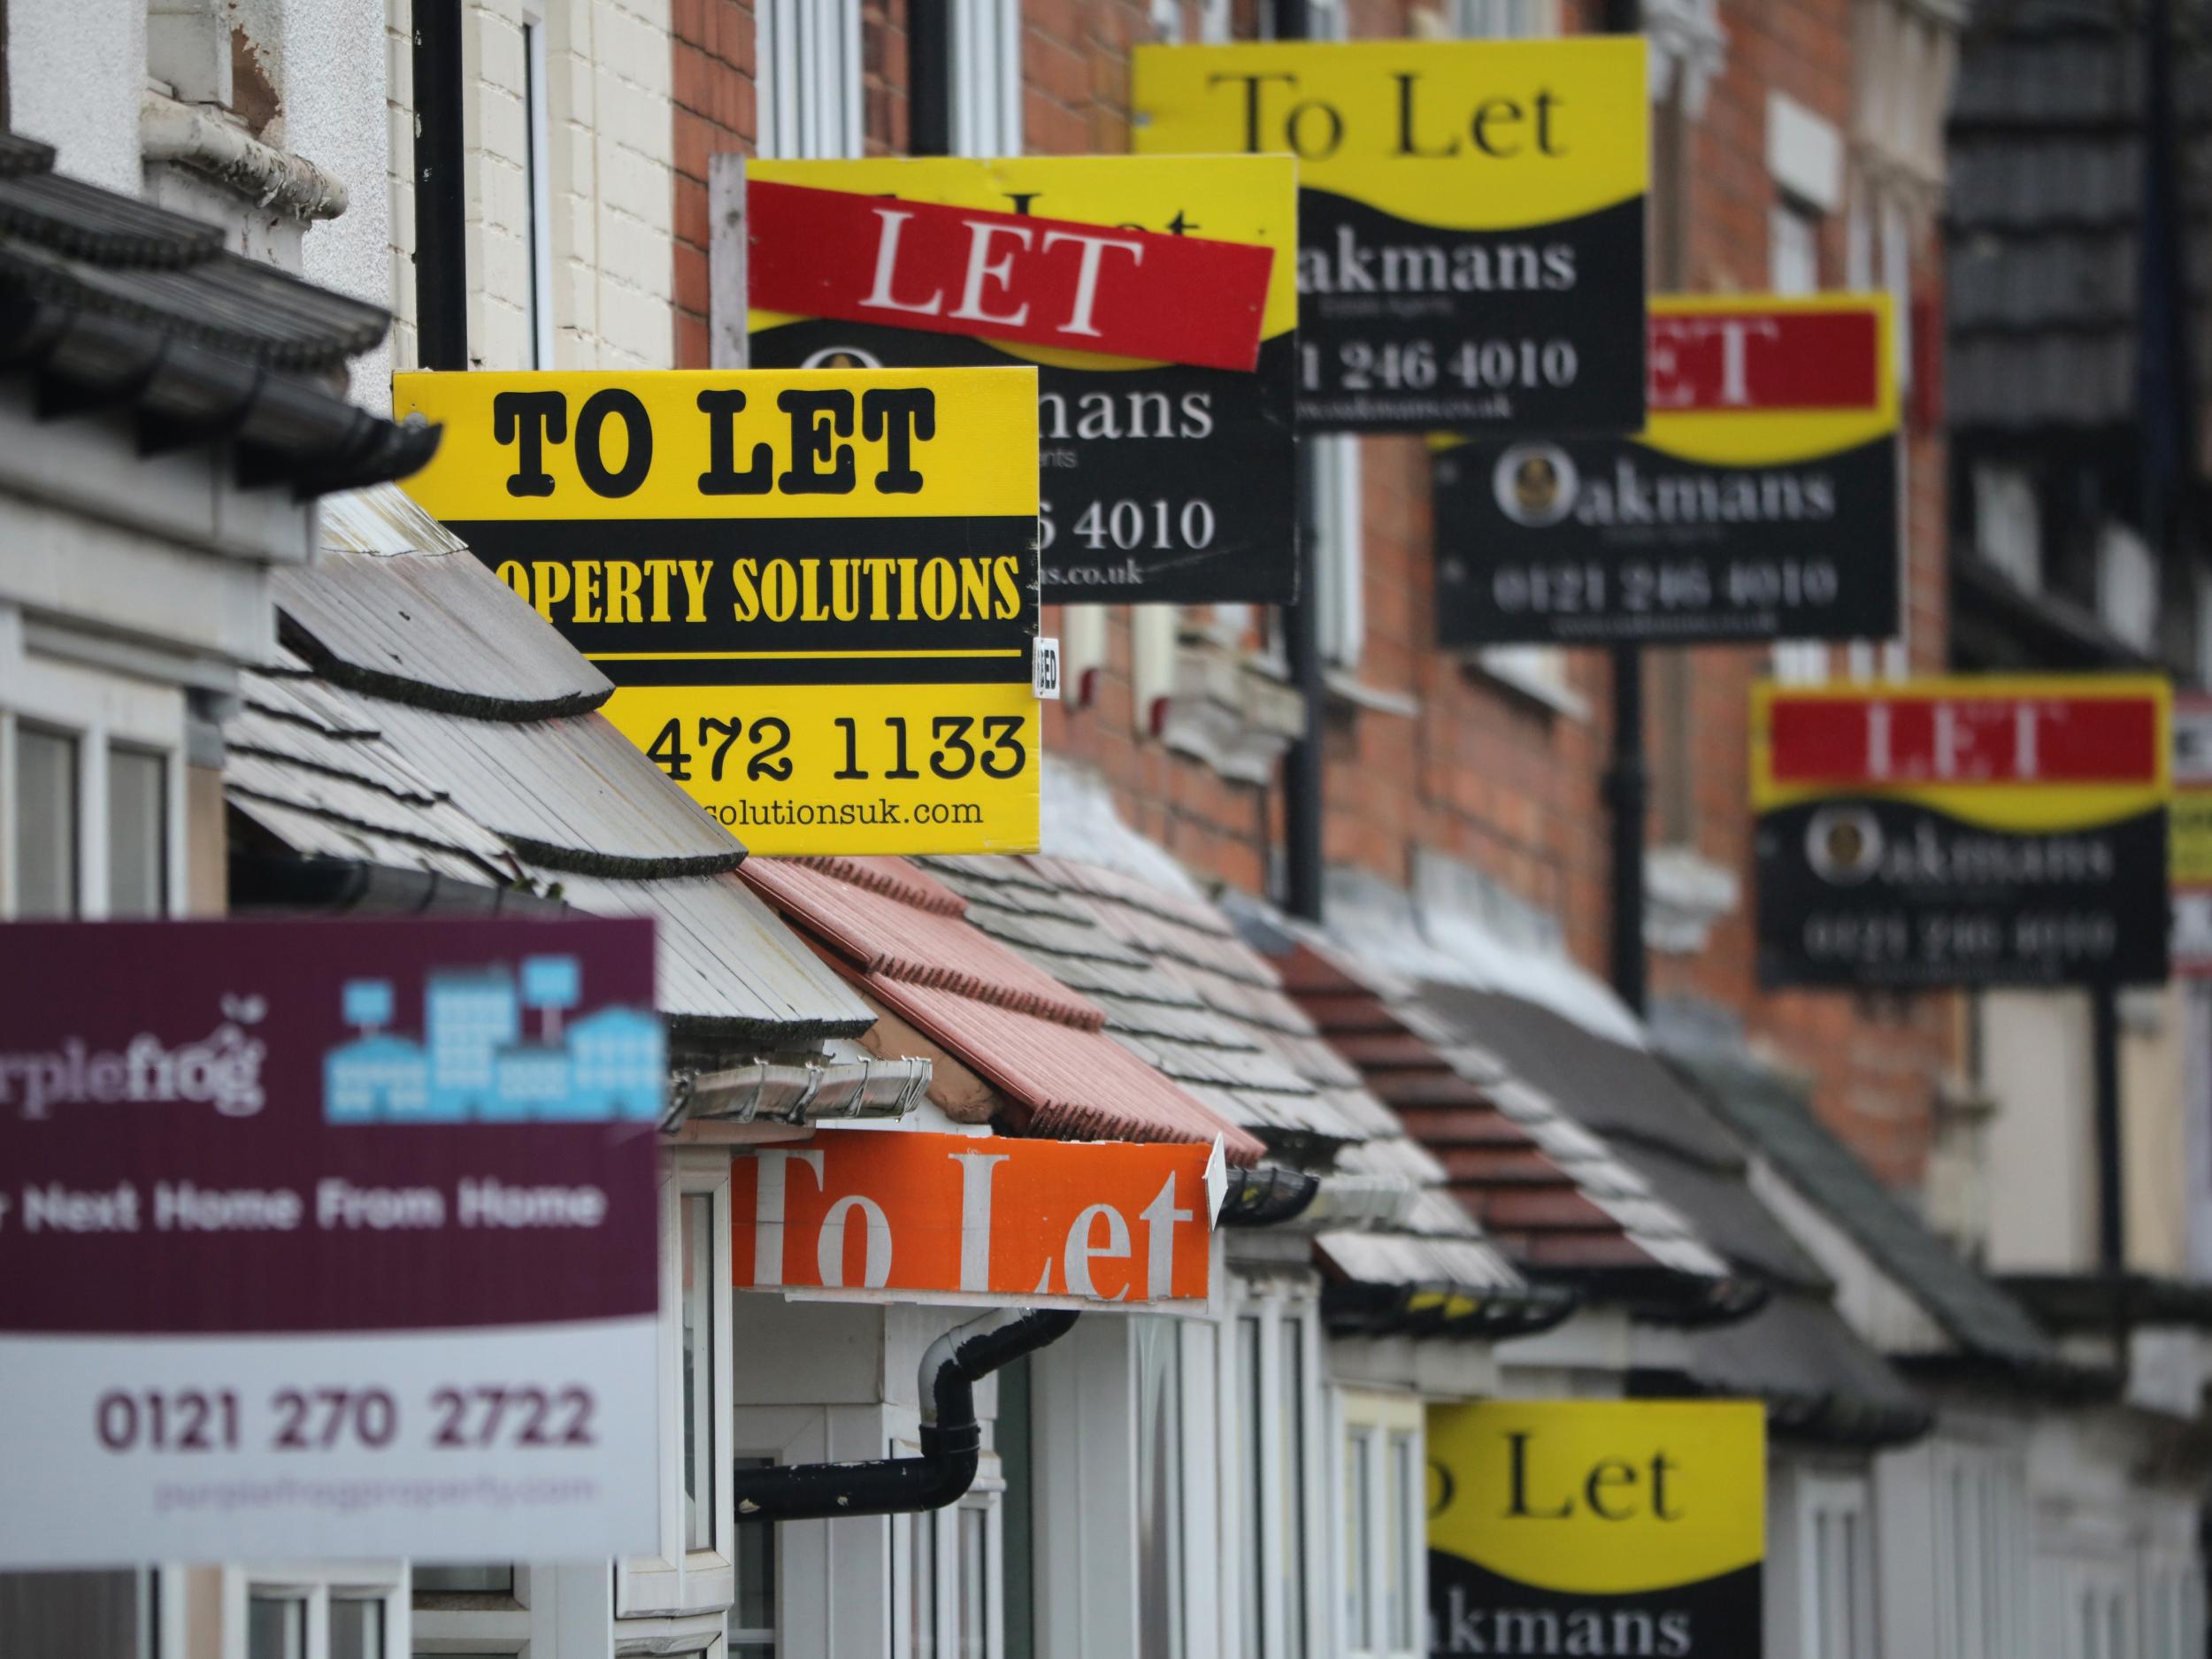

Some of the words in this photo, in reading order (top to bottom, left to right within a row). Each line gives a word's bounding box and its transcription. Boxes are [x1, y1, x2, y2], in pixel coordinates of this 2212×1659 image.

[1206, 71, 1343, 162] To
[1389, 70, 1568, 158] Let
[857, 208, 1144, 337] LET
[1340, 339, 1438, 390] 246
[1448, 338, 1578, 388] 4010
[493, 388, 653, 498] TO
[697, 388, 935, 496] LET
[1492, 442, 1838, 527] Oakmans
[1072, 498, 1215, 550] 4010
[495, 559, 713, 623] OPERTY
[732, 556, 1022, 622] SOLUTIONS
[646, 717, 793, 781] 472
[833, 716, 1026, 780] 1133
[22, 1182, 139, 1233] Next
[154, 1180, 303, 1233] Home
[316, 1178, 445, 1228] From
[457, 1177, 609, 1228] Home
[731, 1149, 893, 1288] To
[949, 1153, 1194, 1302] Let
[95, 1387, 242, 1454] 0121
[269, 1386, 398, 1452] 270
[431, 1385, 597, 1449] 2722
[1502, 1430, 1684, 1522] Let
